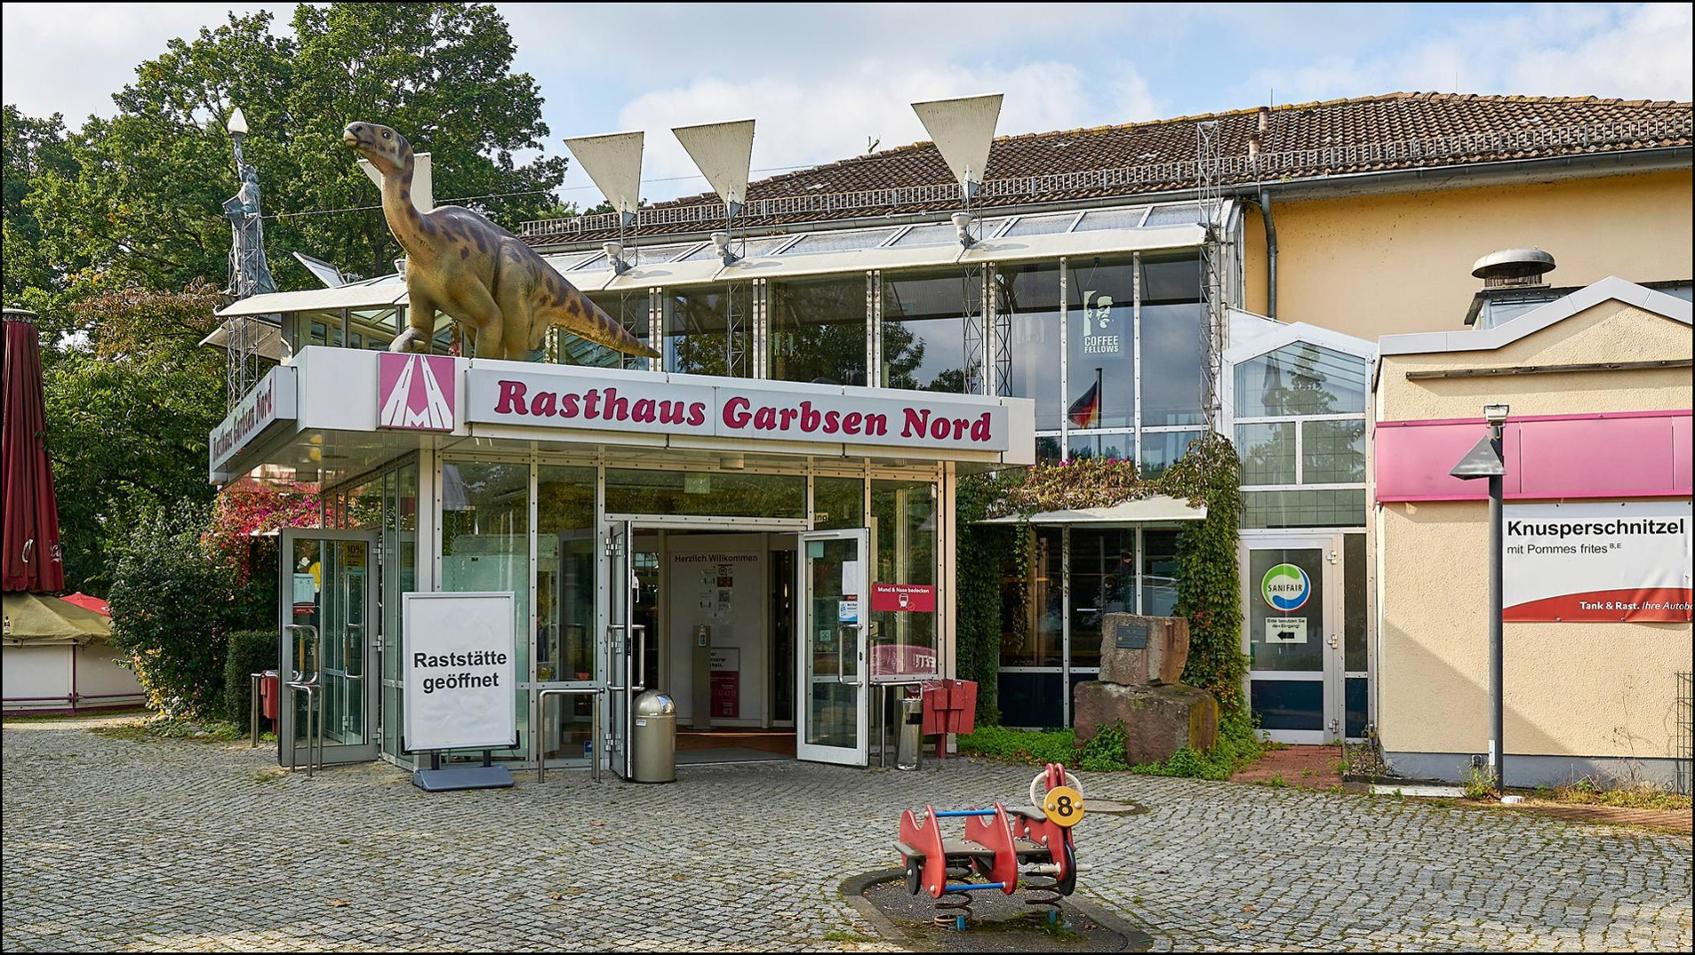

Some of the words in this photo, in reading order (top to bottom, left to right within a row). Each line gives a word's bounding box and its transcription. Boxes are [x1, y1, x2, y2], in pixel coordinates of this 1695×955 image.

[1084, 335, 1119, 347] COFFEE
[1084, 346, 1119, 354] FELLOWS
[493, 379, 706, 427] Rasthaus
[722, 396, 888, 436] Garbsen
[901, 408, 992, 442] Nord
[1507, 518, 1685, 539] Knusperschnitzel
[1507, 544, 1523, 554] mit
[1528, 544, 1577, 554] Pommes
[1581, 543, 1608, 553] frites
[674, 553, 707, 562] Herzlich
[708, 553, 758, 563] Willkommen
[1268, 584, 1303, 592] SANIFAIR
[1580, 602, 1603, 610] Tank
[1605, 602, 1614, 610] &
[1616, 602, 1640, 610] Rast.
[1642, 601, 1661, 610] Ihre
[413, 650, 508, 668] Raststätte
[423, 672, 500, 694] geöffnet
[1057, 795, 1074, 817] 8
